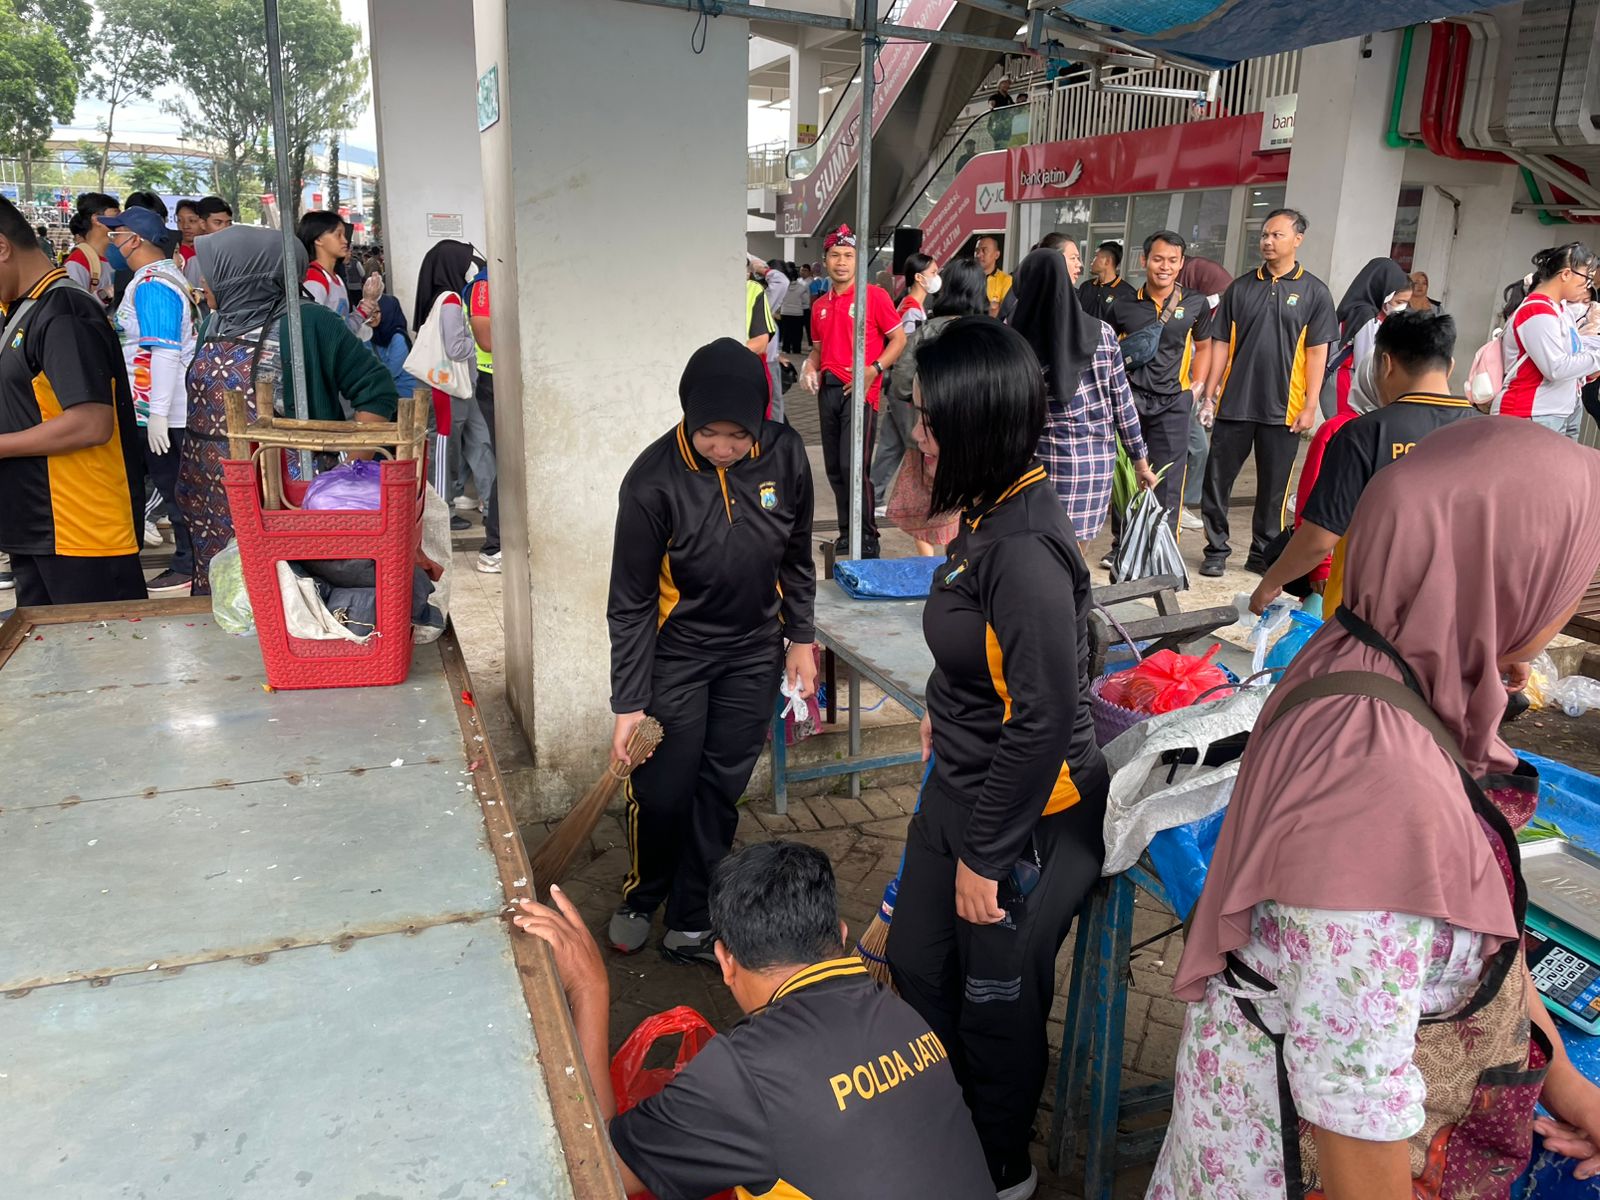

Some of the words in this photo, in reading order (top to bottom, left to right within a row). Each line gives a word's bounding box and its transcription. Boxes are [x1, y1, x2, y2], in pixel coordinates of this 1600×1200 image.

[1545, 958, 1554, 967] 4
[1555, 964, 1567, 973] 5
[1567, 970, 1578, 980] 6
[1564, 955, 1575, 965] 8
[1575, 963, 1586, 971] 9
[1537, 966, 1545, 974] 1
[1546, 972, 1558, 981] 2
[1557, 979, 1569, 988] 3
[829, 1050, 915, 1111] POLDA
